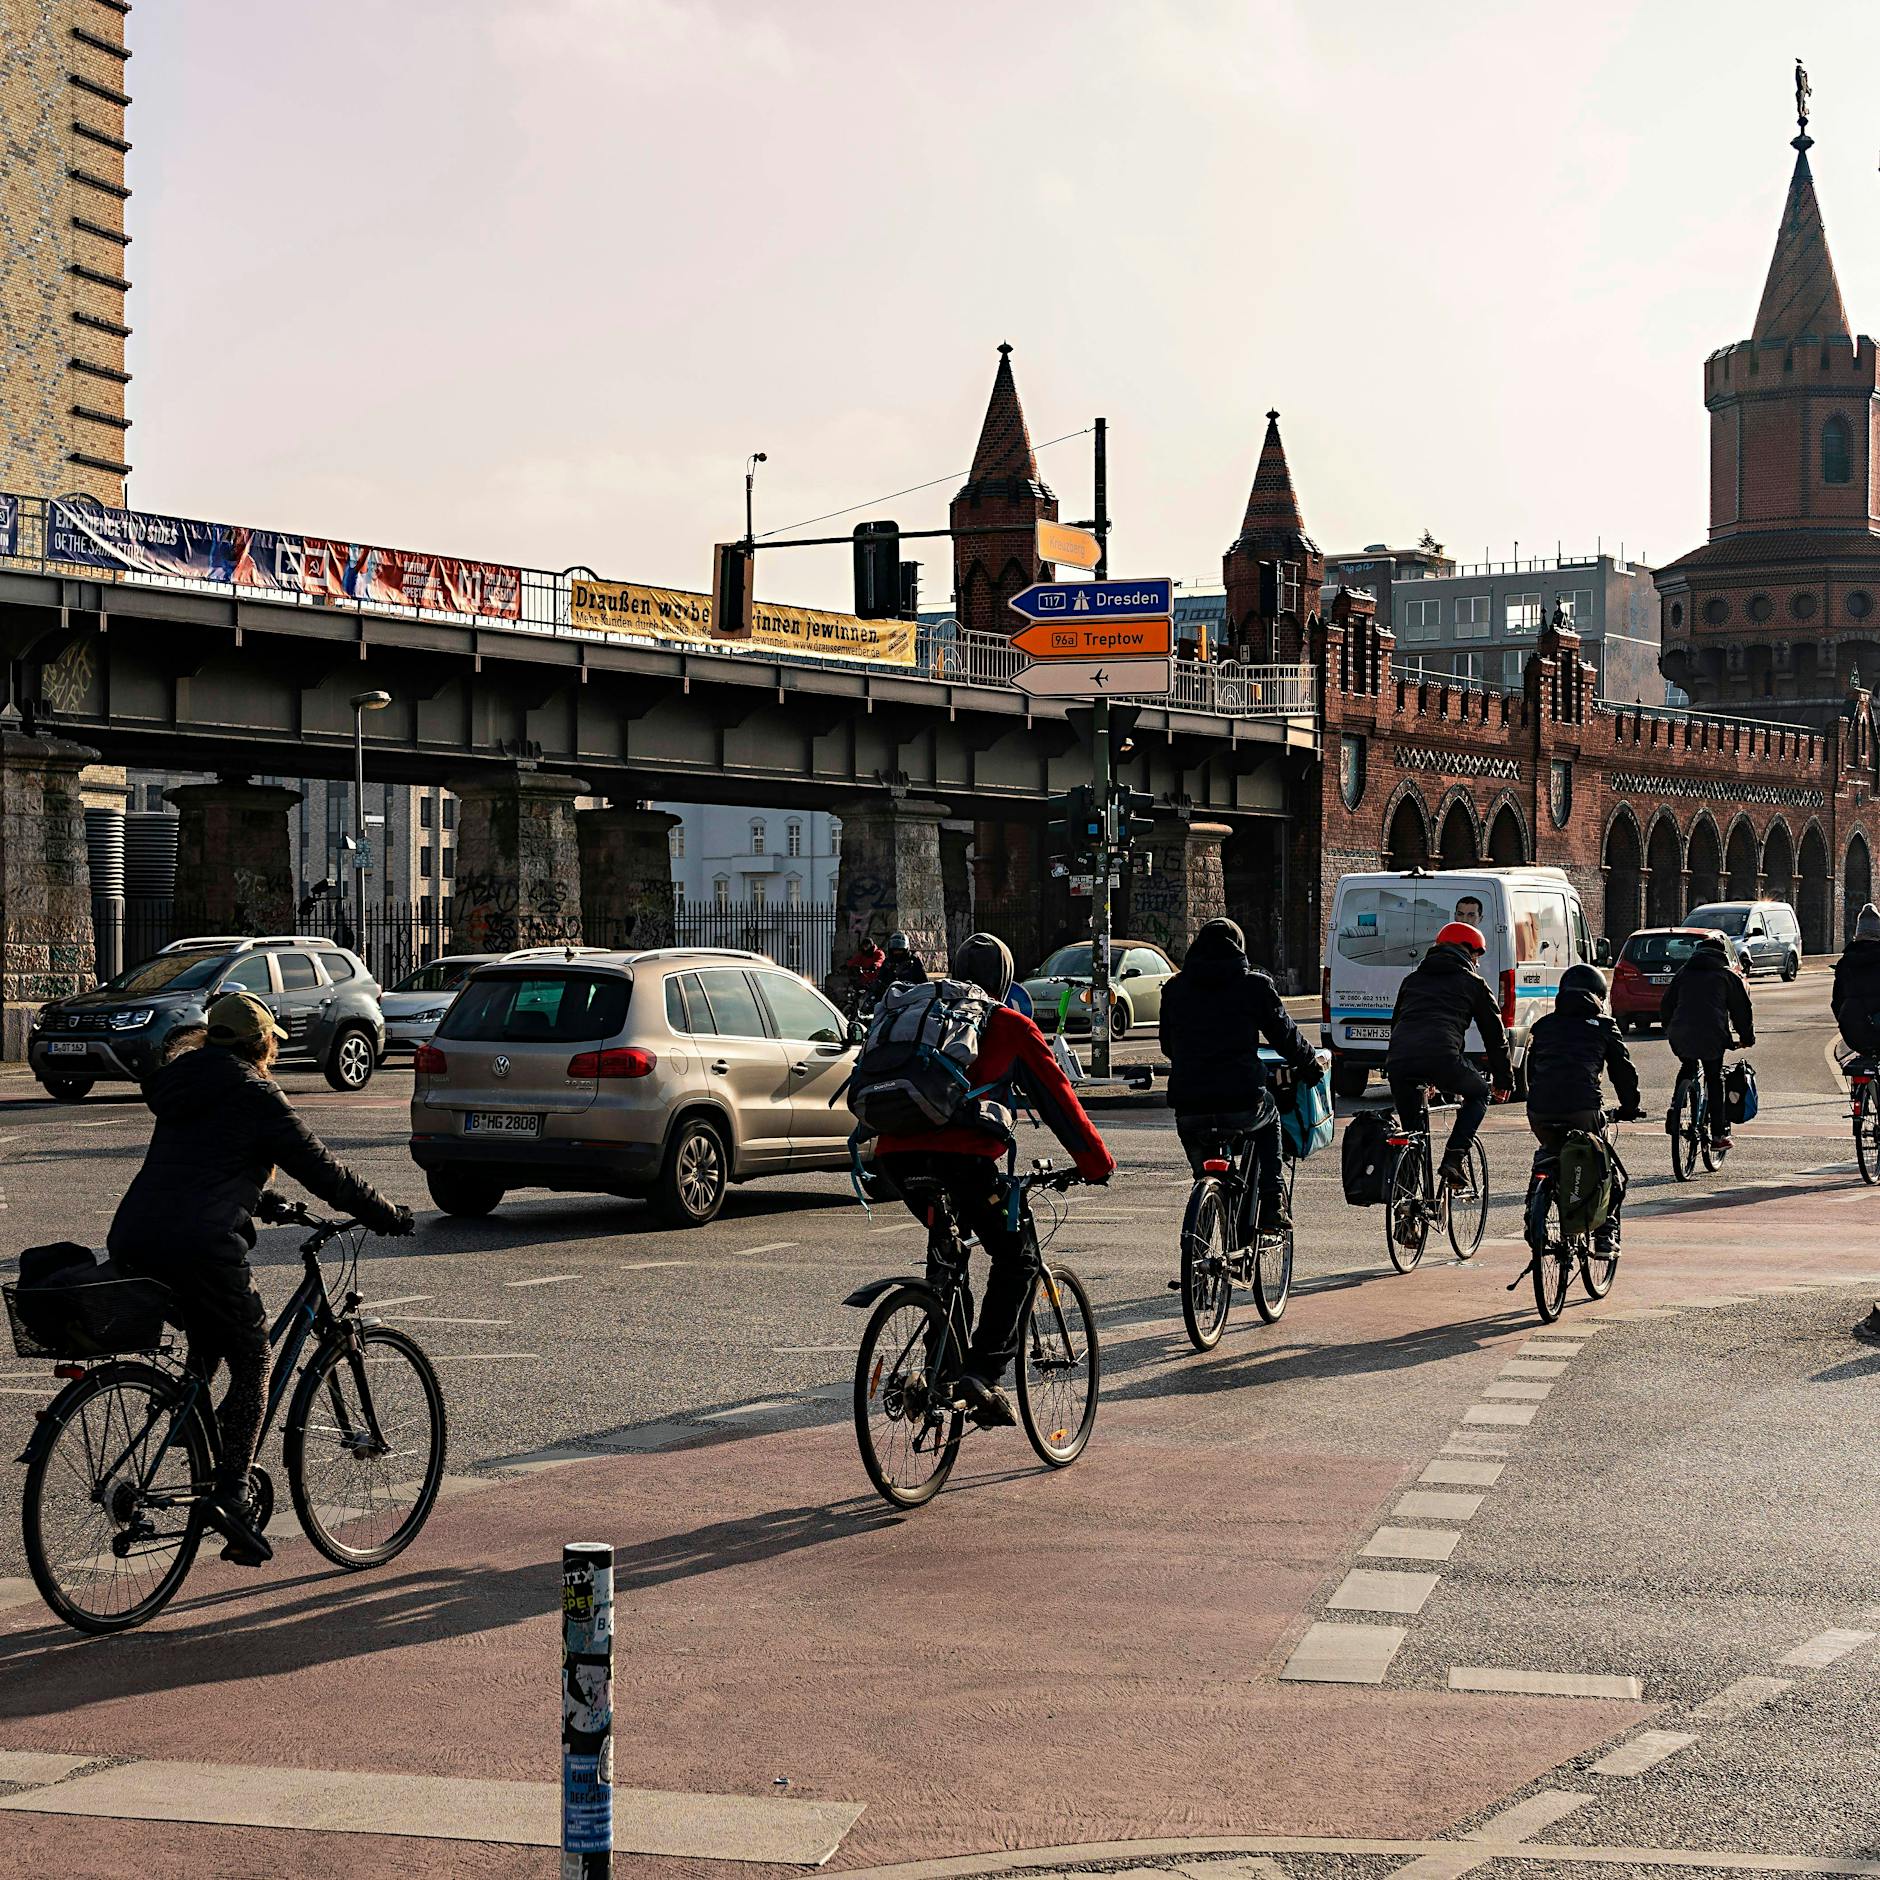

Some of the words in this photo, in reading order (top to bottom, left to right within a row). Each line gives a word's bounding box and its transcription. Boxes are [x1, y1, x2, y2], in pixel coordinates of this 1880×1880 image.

[56, 510, 122, 537] EXPERIENCE
[147, 525, 177, 546] SIDES
[55, 533, 68, 551] OF
[69, 535, 88, 554] THE
[89, 538, 116, 558] SAME
[117, 542, 145, 562] STORY
[1049, 535, 1085, 559] Kreuzberg
[483, 585, 516, 602] MUSEUM
[576, 585, 650, 615] Draußen
[1044, 595, 1059, 607] 117
[1096, 591, 1159, 606] Dresden
[576, 611, 598, 625] Mehr
[1055, 635, 1074, 645] 96a
[1084, 632, 1144, 648] Treptow
[793, 641, 880, 659] www.draussenwerber.de
[1379, 1029, 1391, 1038] 35
[472, 1114, 480, 1129] B
[486, 1115, 503, 1129] HG
[505, 1116, 536, 1130] 2808
